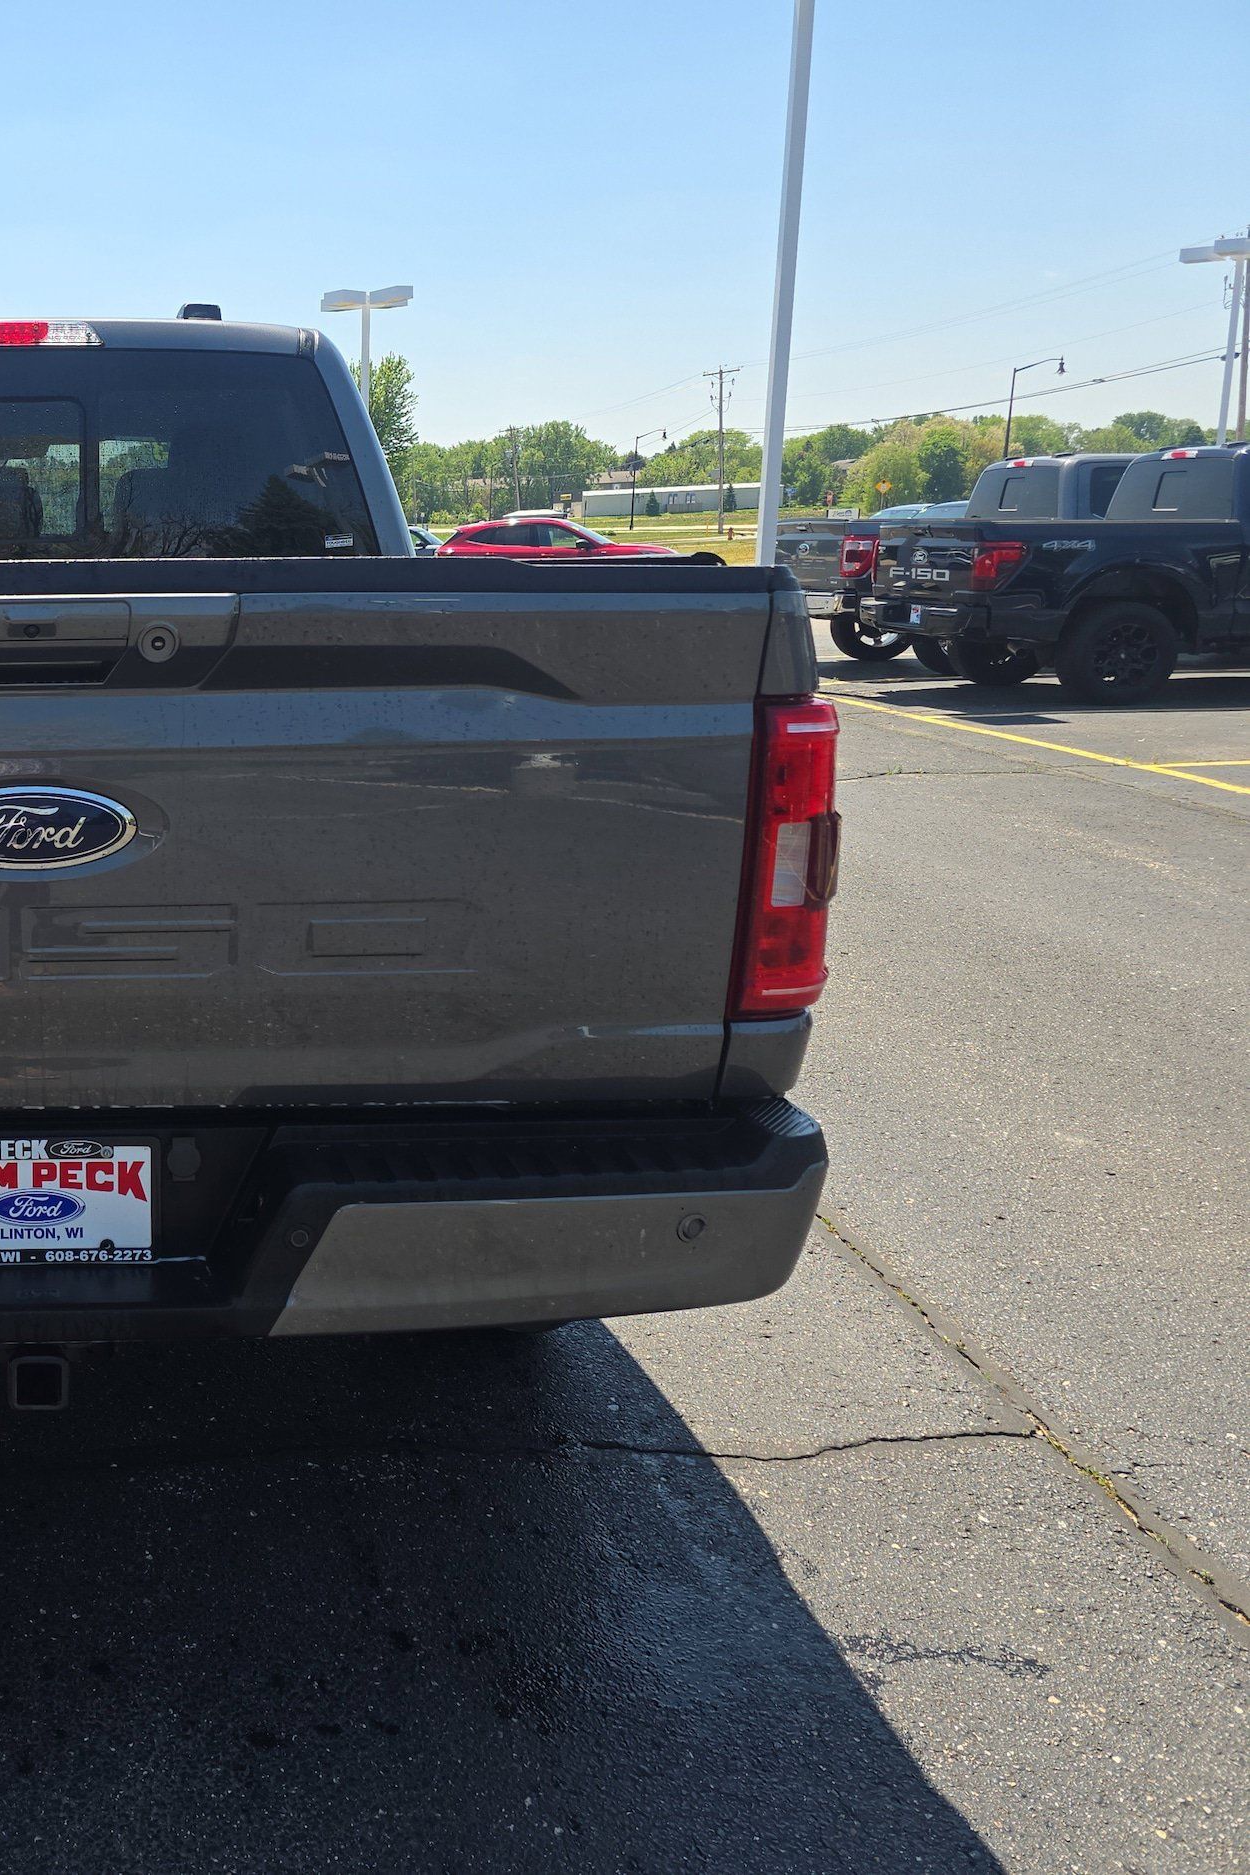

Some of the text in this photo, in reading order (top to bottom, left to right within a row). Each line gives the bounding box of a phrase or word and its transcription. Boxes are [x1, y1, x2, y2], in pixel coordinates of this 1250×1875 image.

[889, 566, 950, 582] F-150
[59, 1141, 92, 1155] Ford
[32, 1161, 148, 1202] PECK
[8, 1194, 64, 1218] Ford
[65, 1227, 84, 1239] WI
[0, 1250, 21, 1263] WI
[44, 1249, 153, 1262] 608-676-2273
